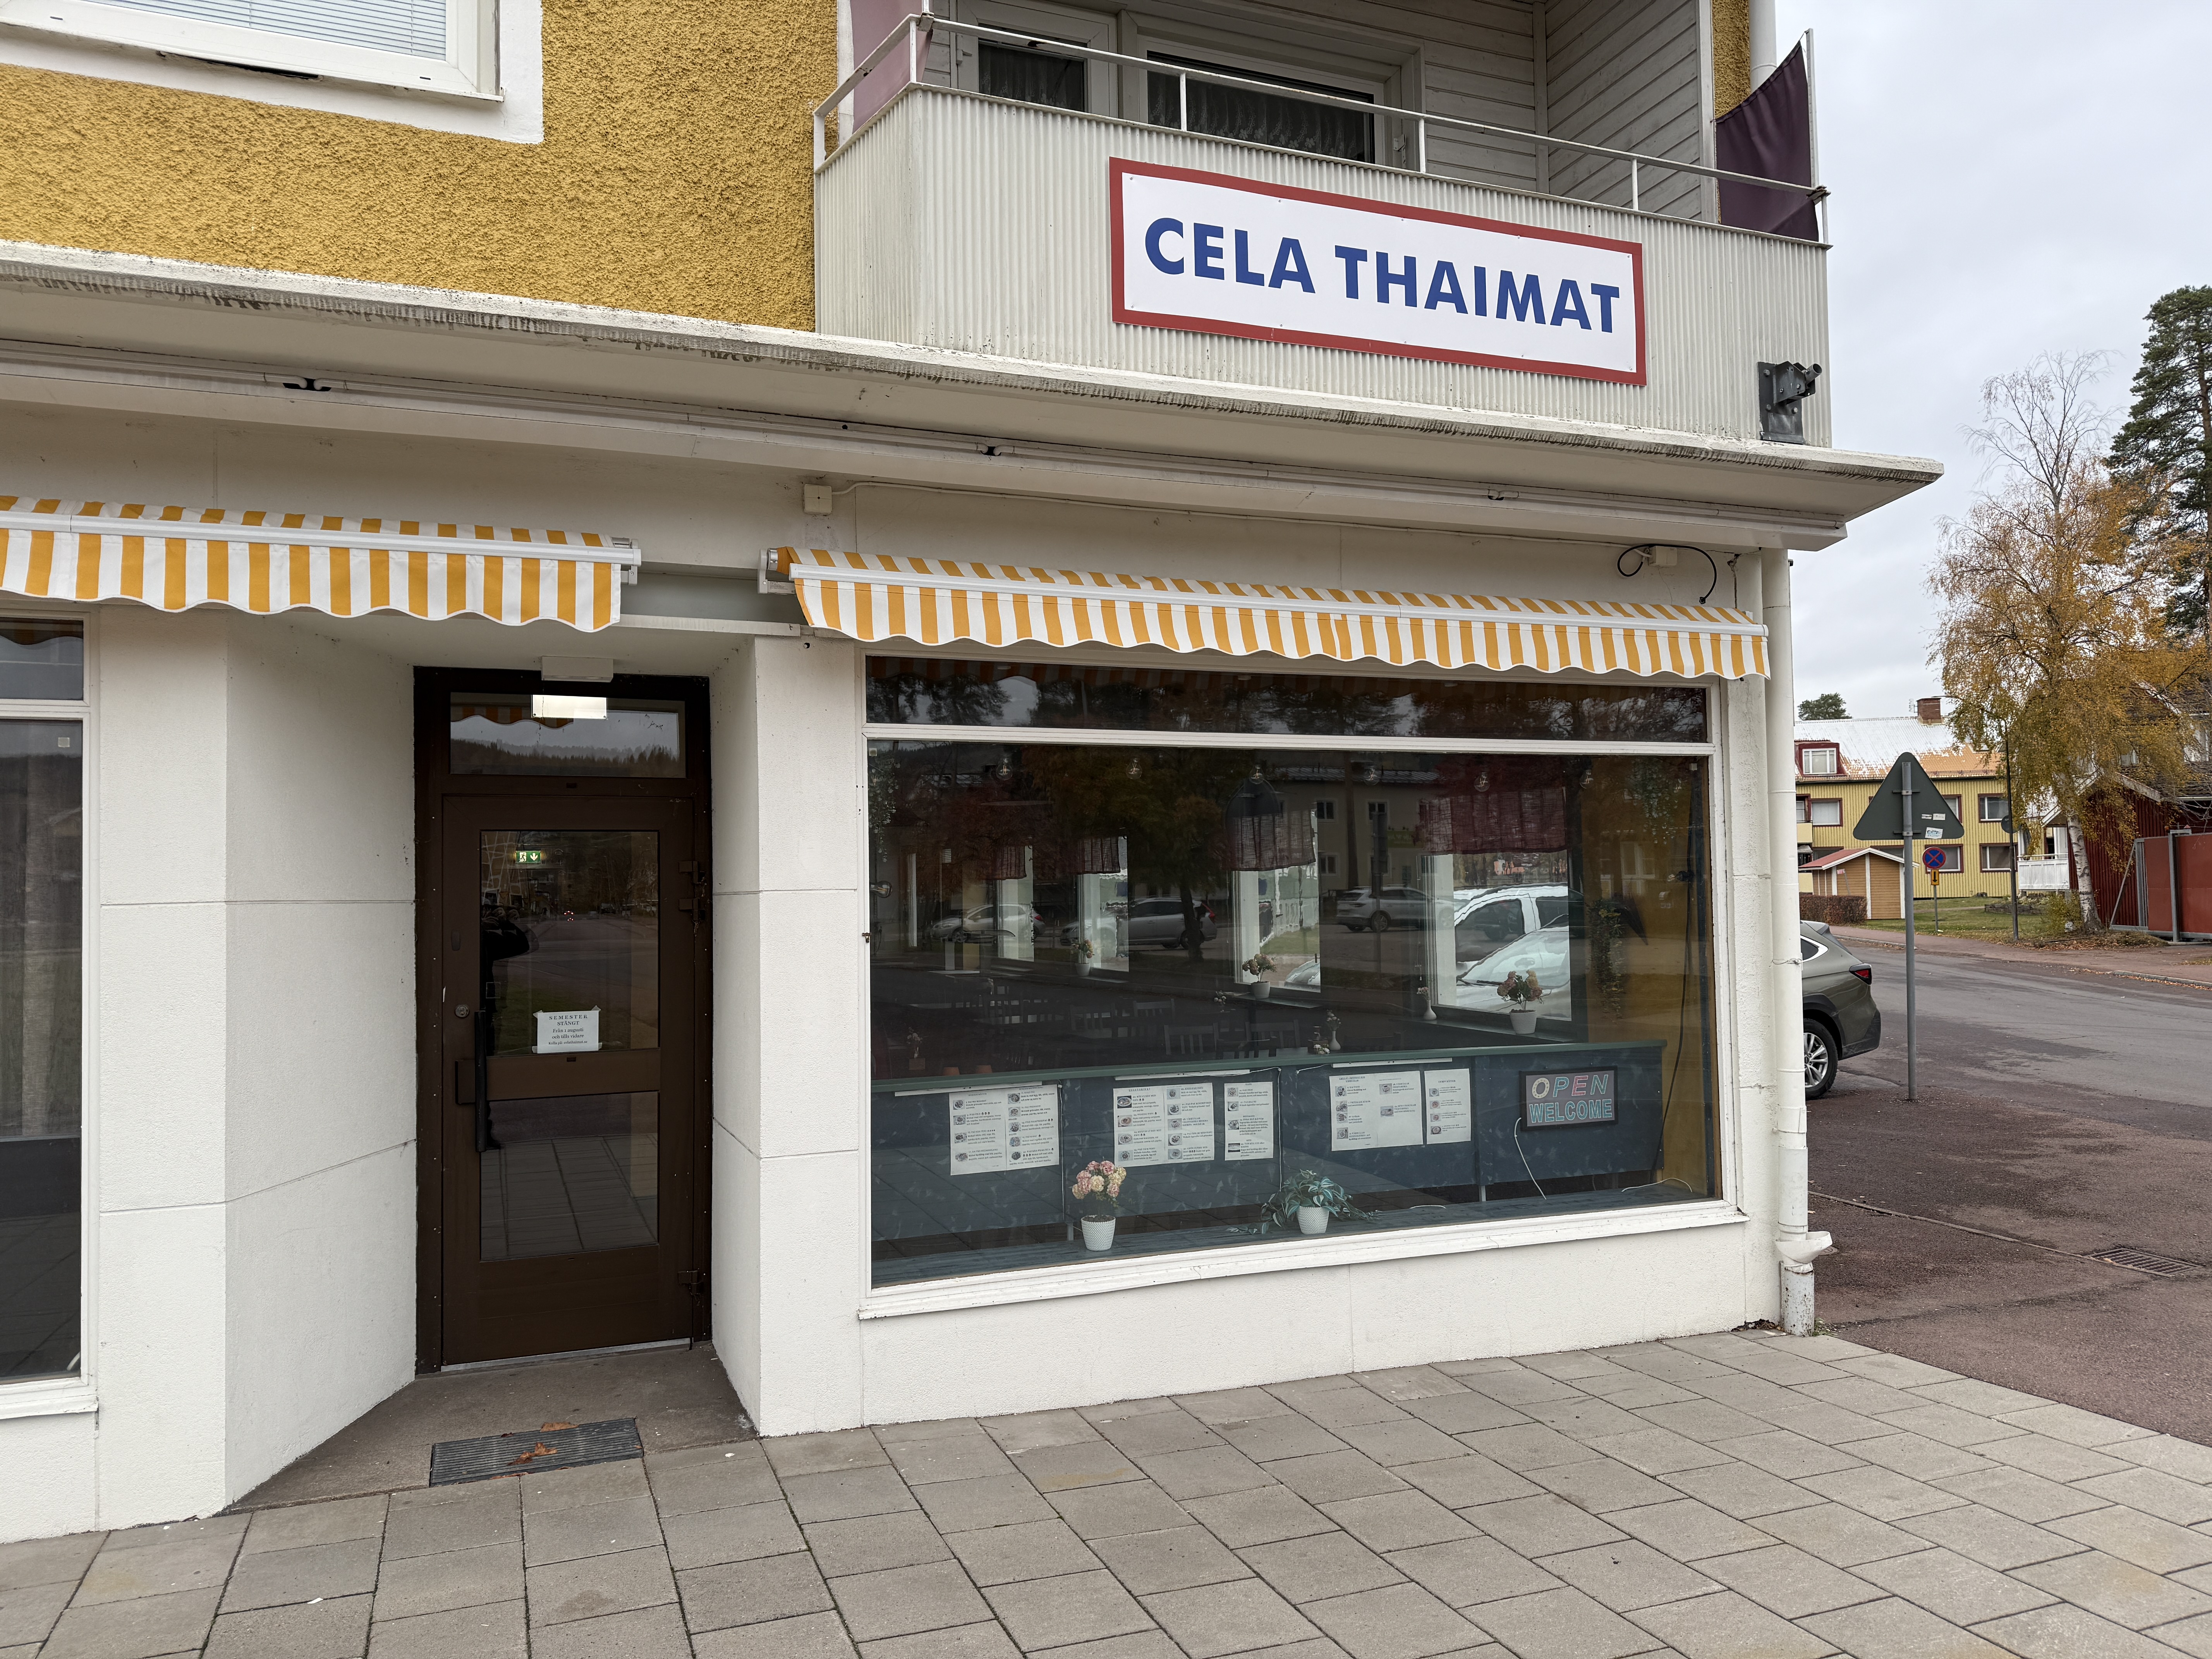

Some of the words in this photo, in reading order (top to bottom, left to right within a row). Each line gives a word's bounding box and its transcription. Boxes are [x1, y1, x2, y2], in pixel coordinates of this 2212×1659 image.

[1145, 217, 1316, 294] CELA
[1334, 245, 1620, 333] THAIMAT
[1532, 1074, 1609, 1099] OPEN
[1529, 1099, 1613, 1123] WELCOME
